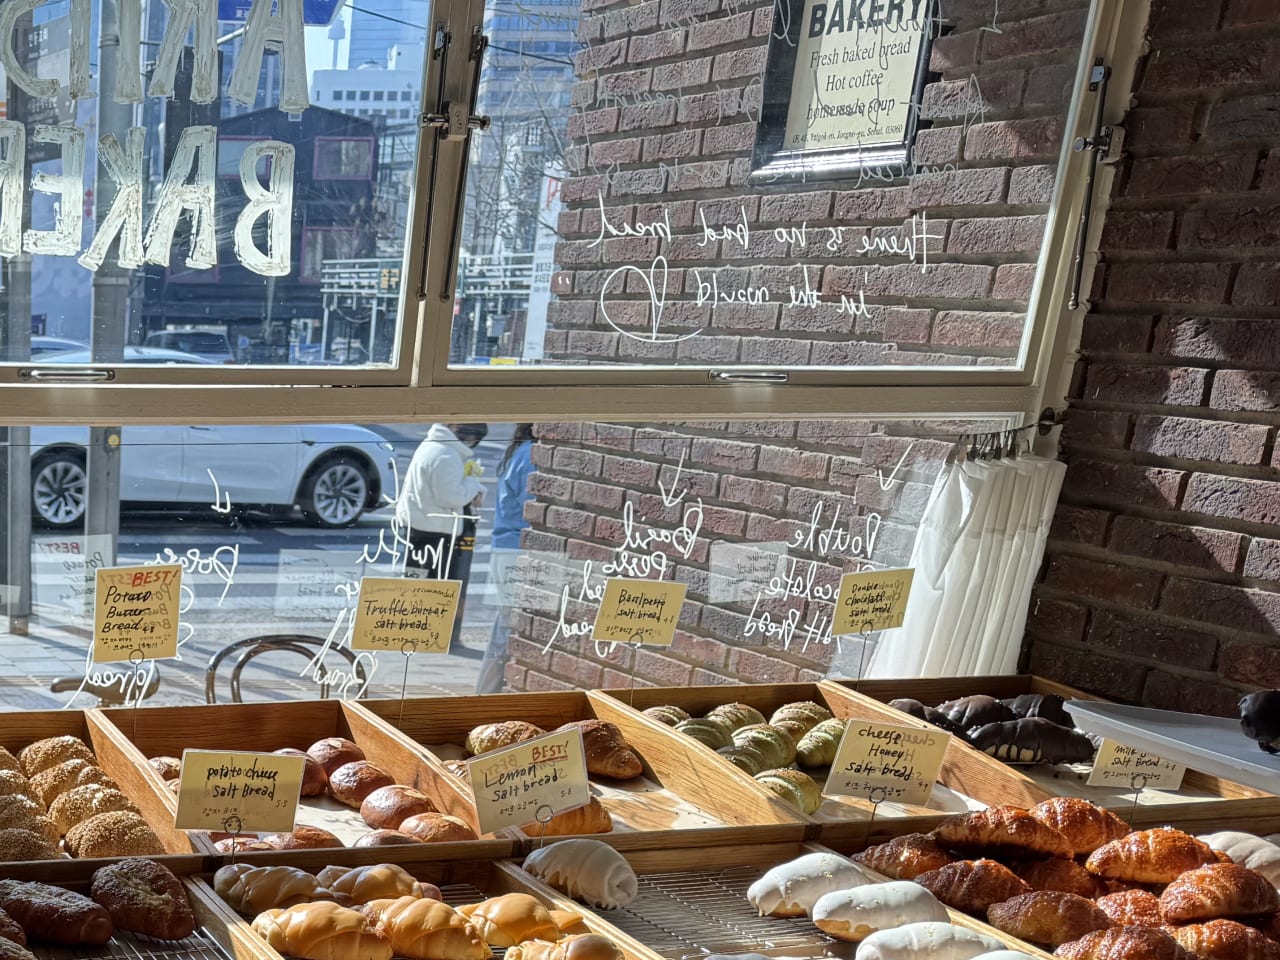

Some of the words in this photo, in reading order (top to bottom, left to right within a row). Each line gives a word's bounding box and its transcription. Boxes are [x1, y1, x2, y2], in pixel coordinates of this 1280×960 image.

[808, 0, 924, 38] BAKERY
[810, 47, 839, 68] Fresh
[842, 42, 875, 63] baked
[879, 36, 912, 58] bread
[826, 73, 845, 91] Hot
[849, 70, 884, 88] coffee
[132, 570, 179, 587] BEST!
[104, 585, 151, 605] Potato
[364, 598, 408, 616] Truffle
[638, 607, 662, 622] bread
[102, 618, 144, 633] Bread
[400, 616, 428, 630] bread
[858, 726, 902, 745] cheese
[531, 741, 569, 761] BEST!
[868, 743, 904, 767] Honey
[207, 765, 242, 780] potato
[485, 765, 536, 788] Lemon
[524, 768, 558, 792] bread
[845, 762, 875, 776] salt
[882, 763, 913, 780] bread
[242, 783, 276, 800] Bread
